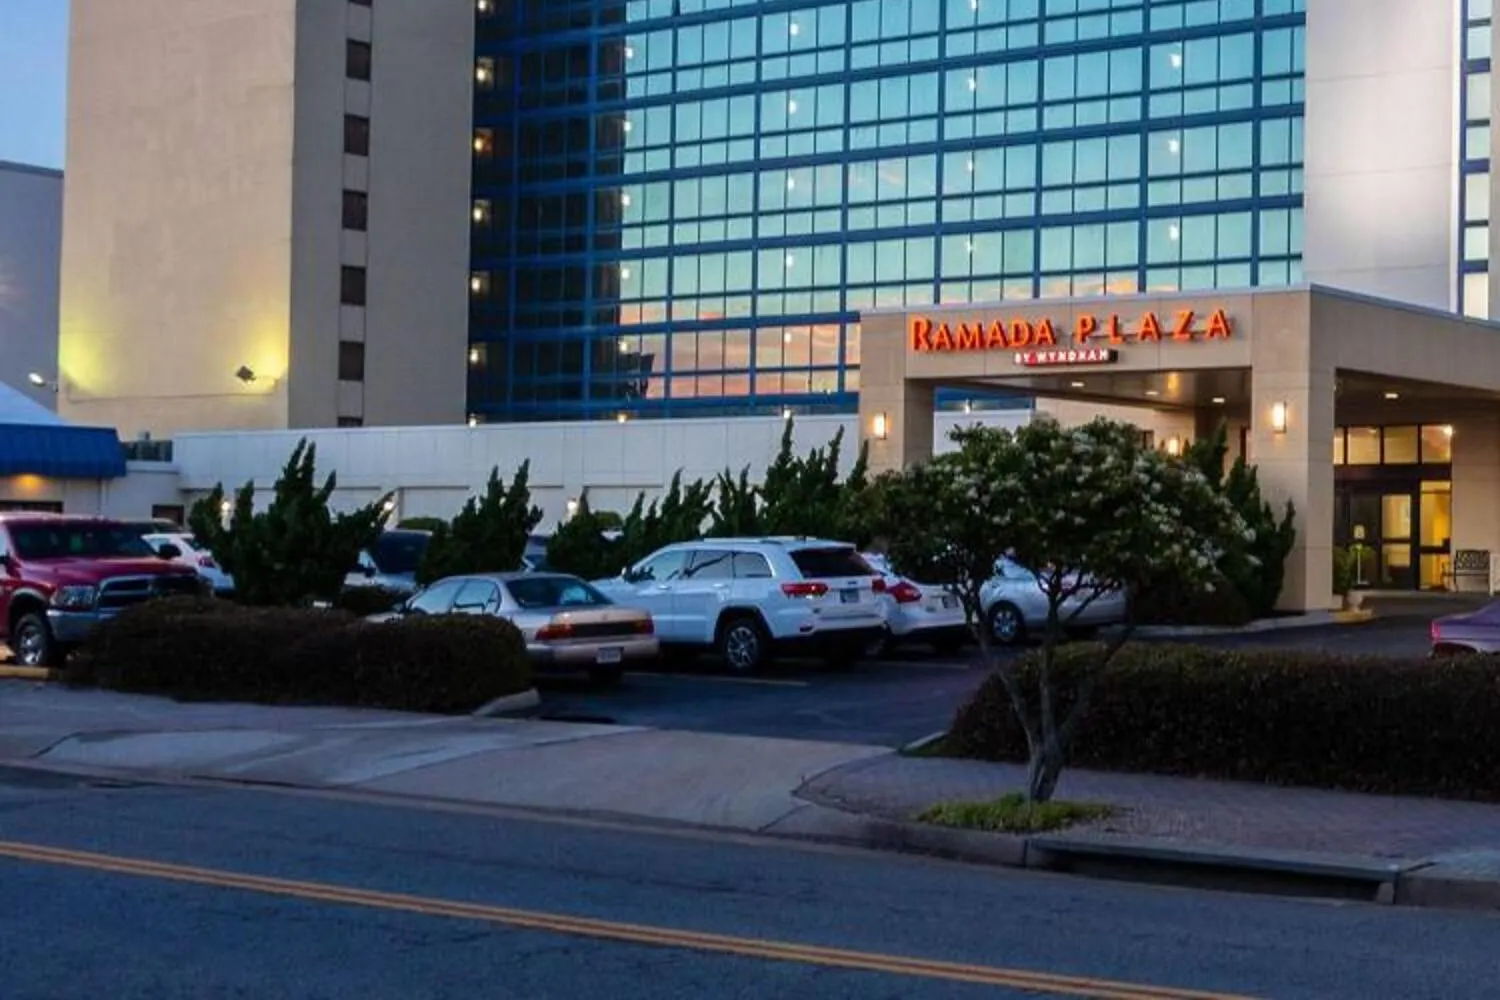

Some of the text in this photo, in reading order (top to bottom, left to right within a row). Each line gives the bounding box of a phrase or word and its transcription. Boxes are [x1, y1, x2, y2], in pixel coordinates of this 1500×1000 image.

[910, 308, 1232, 350] RAMADA PLAZA
[1014, 348, 1109, 364] BY WYNDHAM
